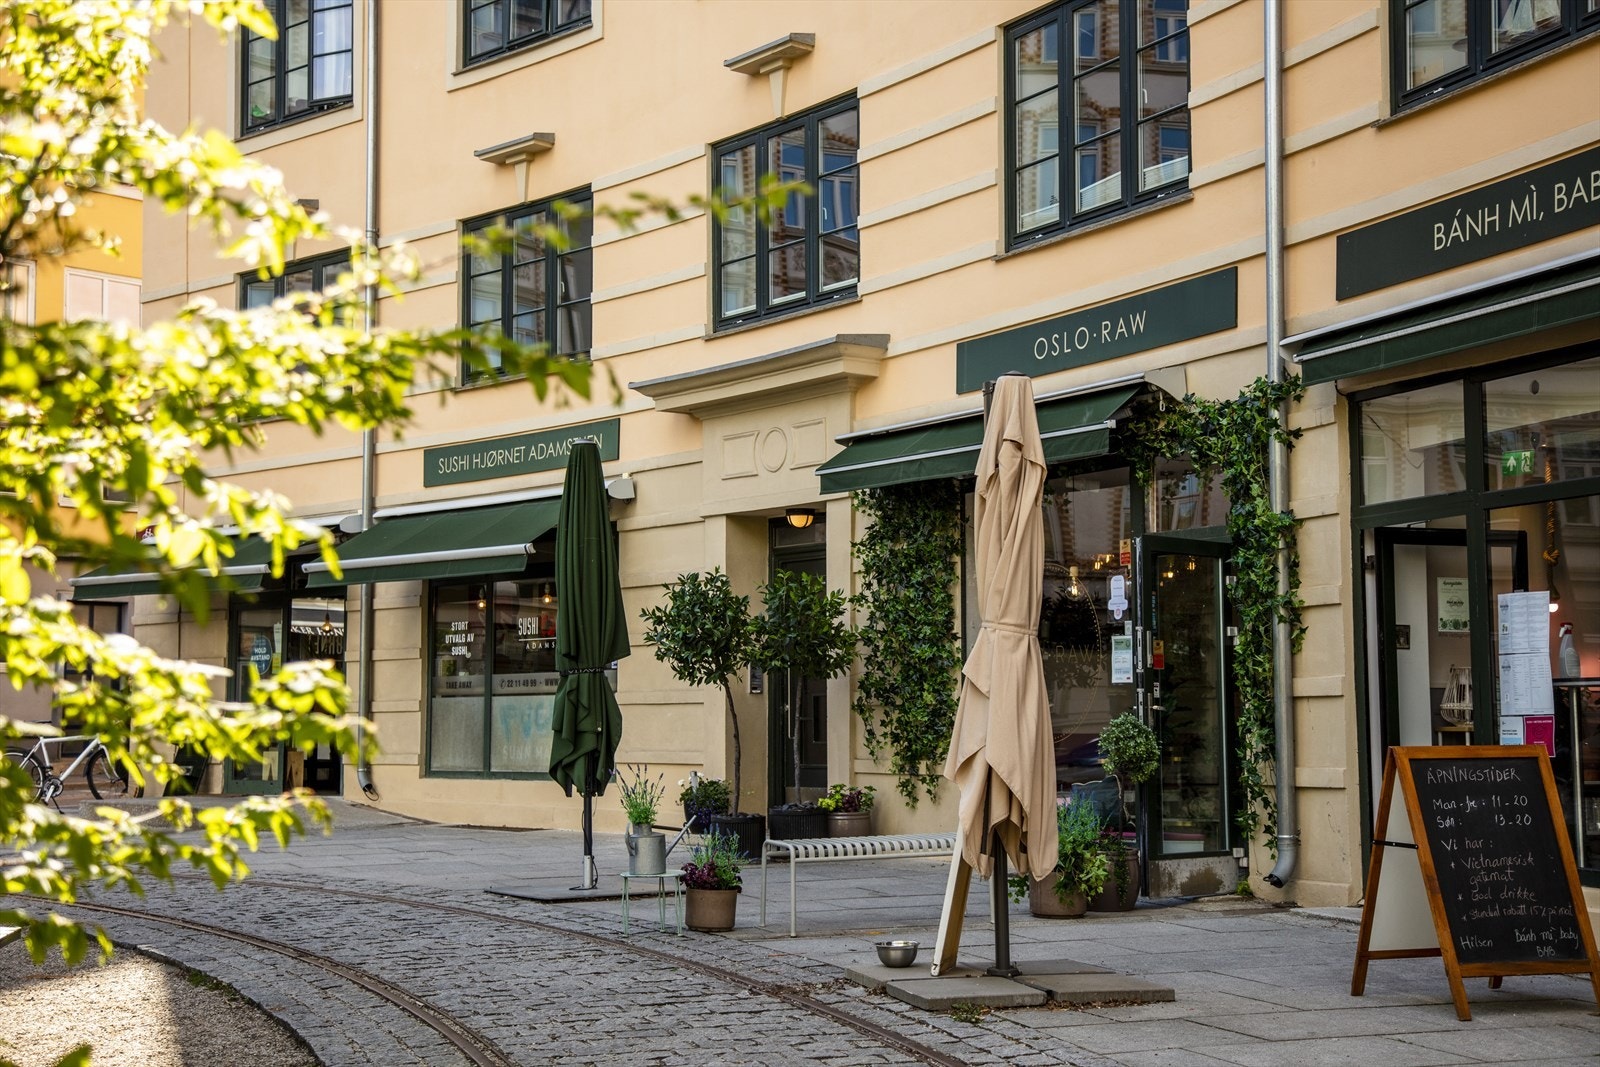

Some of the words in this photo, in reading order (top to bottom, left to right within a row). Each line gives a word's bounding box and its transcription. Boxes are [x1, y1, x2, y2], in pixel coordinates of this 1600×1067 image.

[1434, 204, 1499, 250] BÁNH
[1508, 184, 1544, 228] MÌ,
[438, 455, 470, 474] SUSHI
[473, 446, 526, 469] HJØRNET
[528, 433, 603, 461] ADAMSN
[451, 621, 468, 631] STORT
[518, 616, 539, 635] SUSHI
[445, 634, 466, 644] UTVALG
[467, 632, 475, 643] AV
[451, 646, 470, 657] SUSHI
[1055, 644, 1095, 663] RAW
[446, 681, 457, 689] TAKE
[459, 681, 472, 689] AWAY
[1441, 839, 1458, 851] Vi
[1500, 884, 1536, 902] drikke
[1460, 935, 1493, 950] Hilsen
